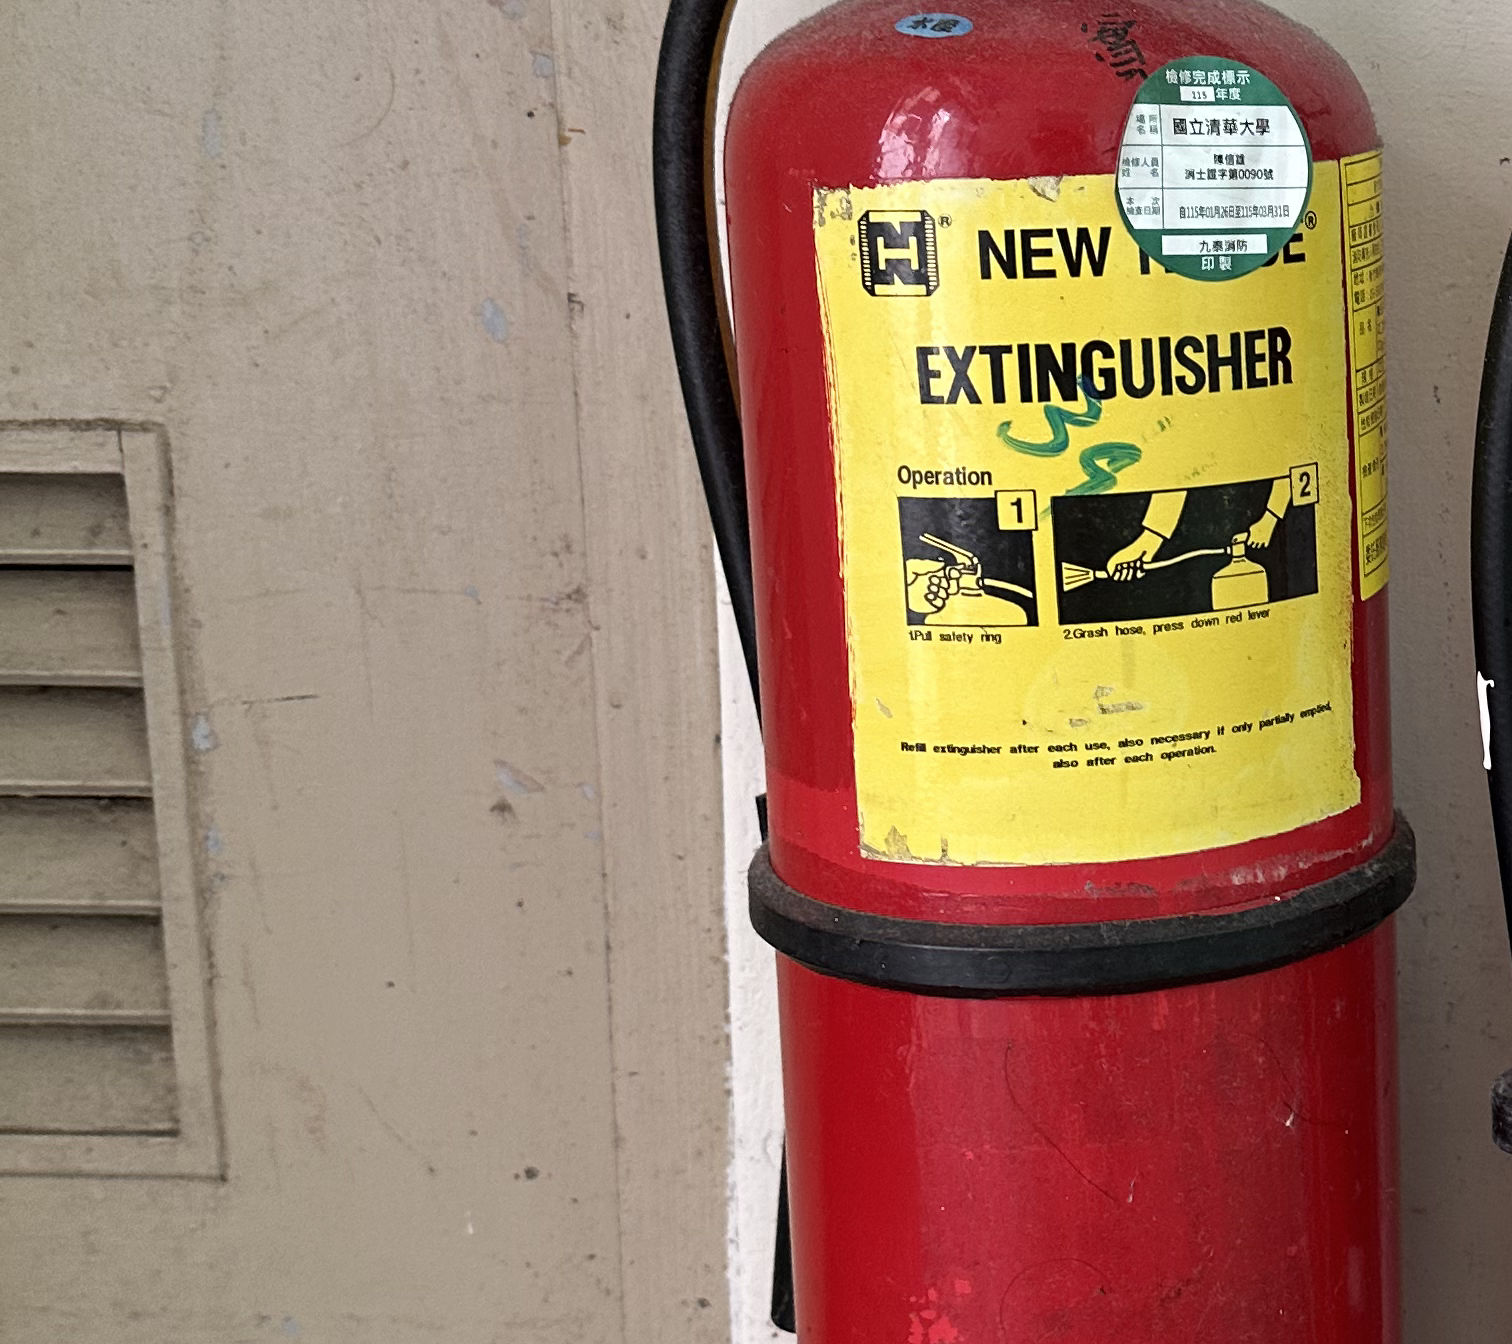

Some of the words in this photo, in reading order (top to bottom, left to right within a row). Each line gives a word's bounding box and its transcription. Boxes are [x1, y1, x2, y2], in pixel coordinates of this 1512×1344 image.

[1165, 69, 1251, 85] 檢修完成標示
[1216, 87, 1241, 101] 年度
[1172, 117, 1270, 136] 國立清華大學
[977, 227, 1112, 280] NEW
[1201, 257, 1232, 270] 印製
[916, 327, 1294, 406] EXTINGUISHER
[896, 465, 993, 490] Operation
[1298, 471, 1312, 498] 2
[1010, 497, 1023, 524] 1
[1153, 620, 1185, 635] press
[1191, 615, 1220, 629] down
[1225, 612, 1243, 625] red
[1248, 608, 1271, 621] lever
[940, 631, 973, 644] safety
[981, 632, 1003, 645] ring
[901, 741, 926, 753] Refill
[933, 743, 1002, 756] extinguisher
[1010, 743, 1040, 754] after
[1048, 742, 1078, 753] each
[1085, 741, 1111, 751] use,
[1118, 737, 1144, 749] also
[1150, 728, 1210, 745] necessary
[1217, 725, 1225, 736] if
[1231, 721, 1253, 734] only
[1259, 712, 1295, 731] partially
[1052, 758, 1078, 769] also
[1086, 755, 1116, 767] after
[1124, 753, 1153, 765] each
[1160, 744, 1217, 762] operation.
